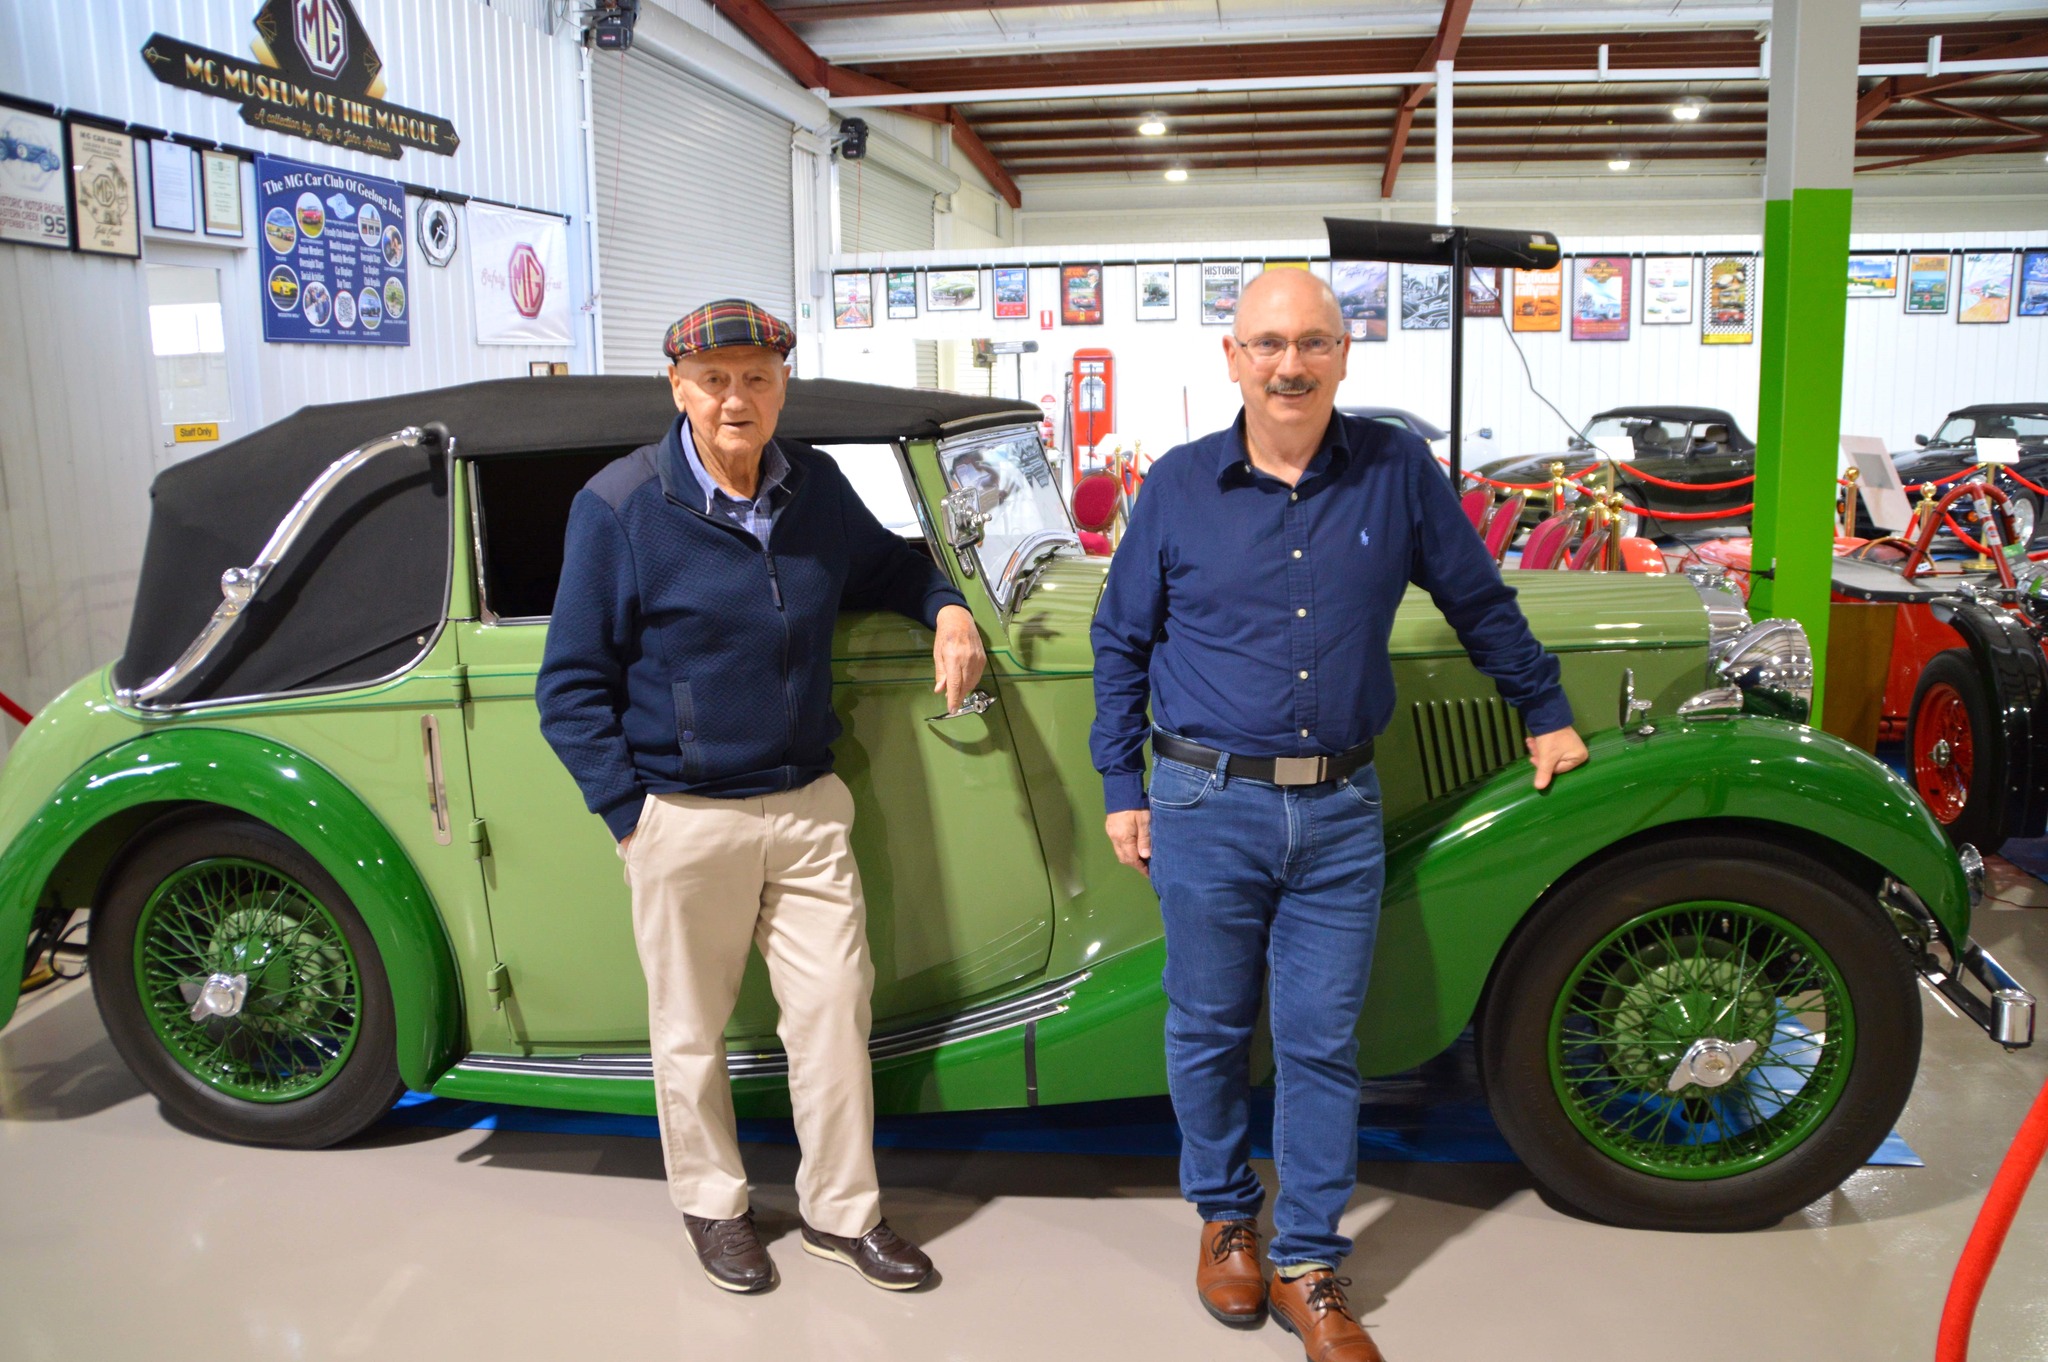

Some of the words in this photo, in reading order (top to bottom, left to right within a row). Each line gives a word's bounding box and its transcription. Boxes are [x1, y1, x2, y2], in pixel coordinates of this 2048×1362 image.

[302, 0, 341, 66] MG
[185, 53, 219, 87] MG
[223, 64, 310, 112] MUSEUM
[313, 91, 337, 118] OF
[339, 97, 374, 129] THE
[375, 108, 440, 146] MARQUE
[266, 113, 301, 130] collection
[93, 134, 106, 143] CAR
[107, 137, 123, 147] CLUB
[263, 179, 284, 196] The
[284, 174, 304, 189] MG
[304, 172, 323, 187] Car
[323, 173, 345, 190] Club
[345, 178, 358, 193] Of
[357, 182, 388, 211] Geelong
[388, 197, 403, 219] Inc.
[513, 253, 541, 309] MG
[1204, 265, 1240, 276] HISTORIC
[180, 428, 196, 438] Staff
[197, 427, 212, 438] Only
